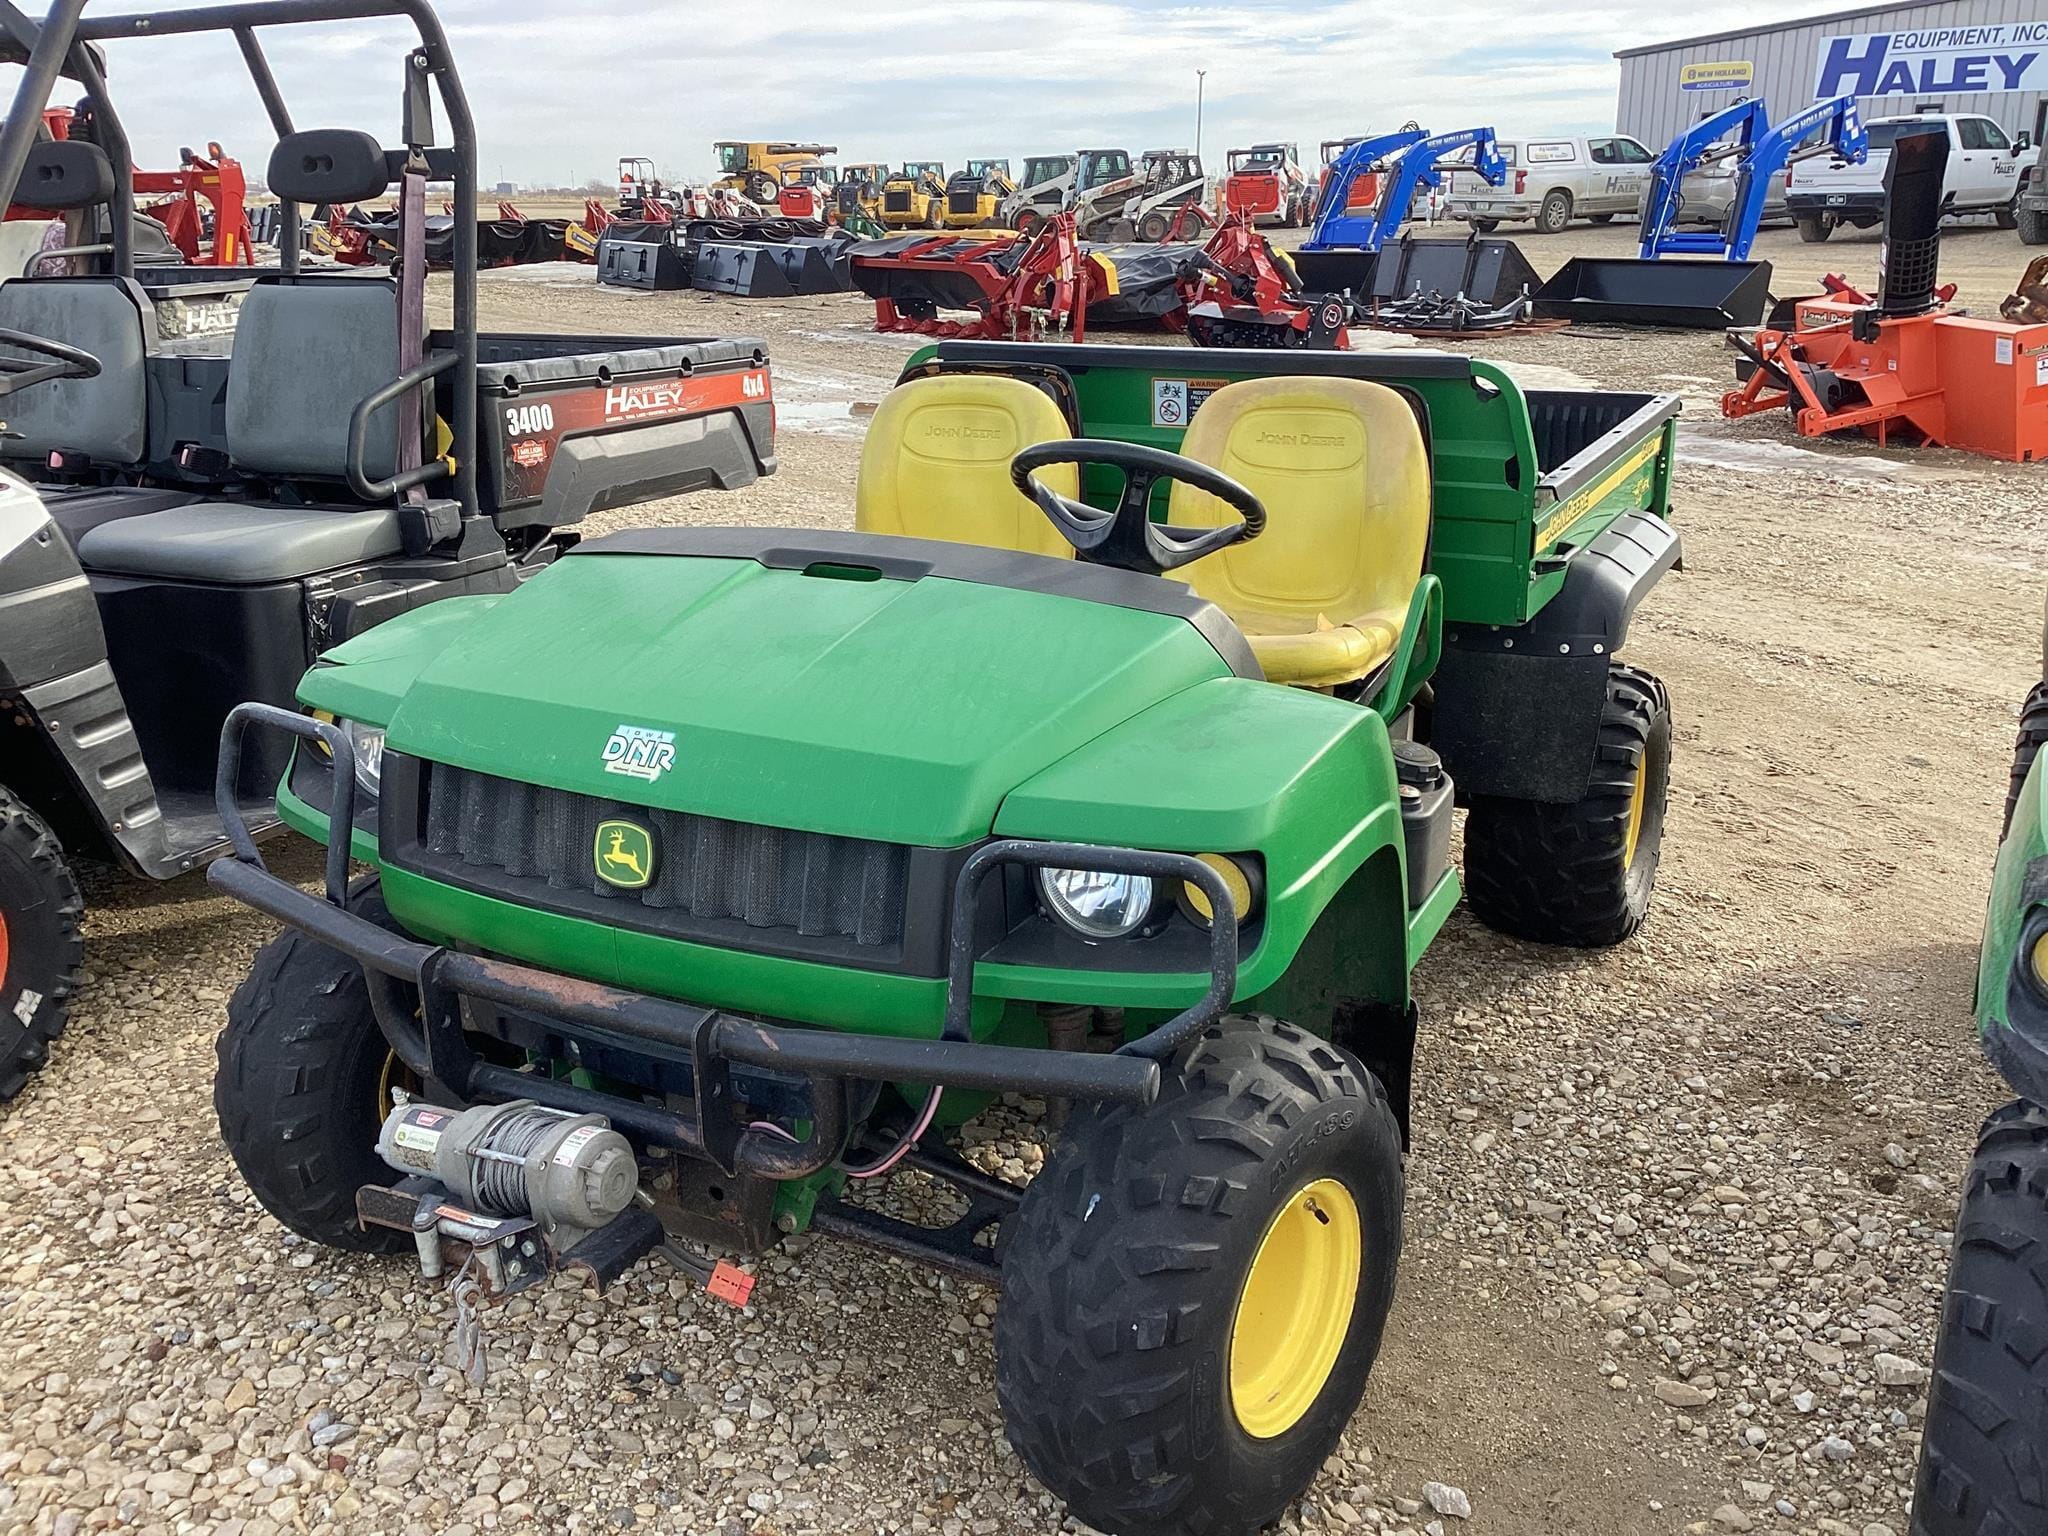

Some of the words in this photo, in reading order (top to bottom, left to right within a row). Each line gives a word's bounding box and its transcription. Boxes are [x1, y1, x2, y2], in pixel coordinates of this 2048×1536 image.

[1892, 27, 2005, 50] EQUIPMENT,
[1714, 69, 1747, 77] HOLLAND
[1816, 35, 2039, 98] HALEY
[1781, 122, 1800, 140] NEW
[1800, 105, 1834, 130] HOLLAND
[1427, 139, 1443, 149] NEW
[1443, 132, 1474, 144] HOLLAND
[1993, 161, 2016, 175] HALEY
[1470, 184, 1494, 194] HALEY
[1803, 309, 1828, 322] Land
[629, 384, 669, 395] EQUIPMENT
[742, 373, 766, 398] 4x4
[1196, 380, 1228, 388] WARNING
[605, 386, 684, 415] HALEY
[506, 403, 554, 436] 3400
[925, 425, 960, 438] JOHN
[963, 427, 1002, 440] DEERE
[1256, 431, 1297, 445] JOHN
[1301, 433, 1346, 447] DEERE
[601, 734, 677, 773] DNR
